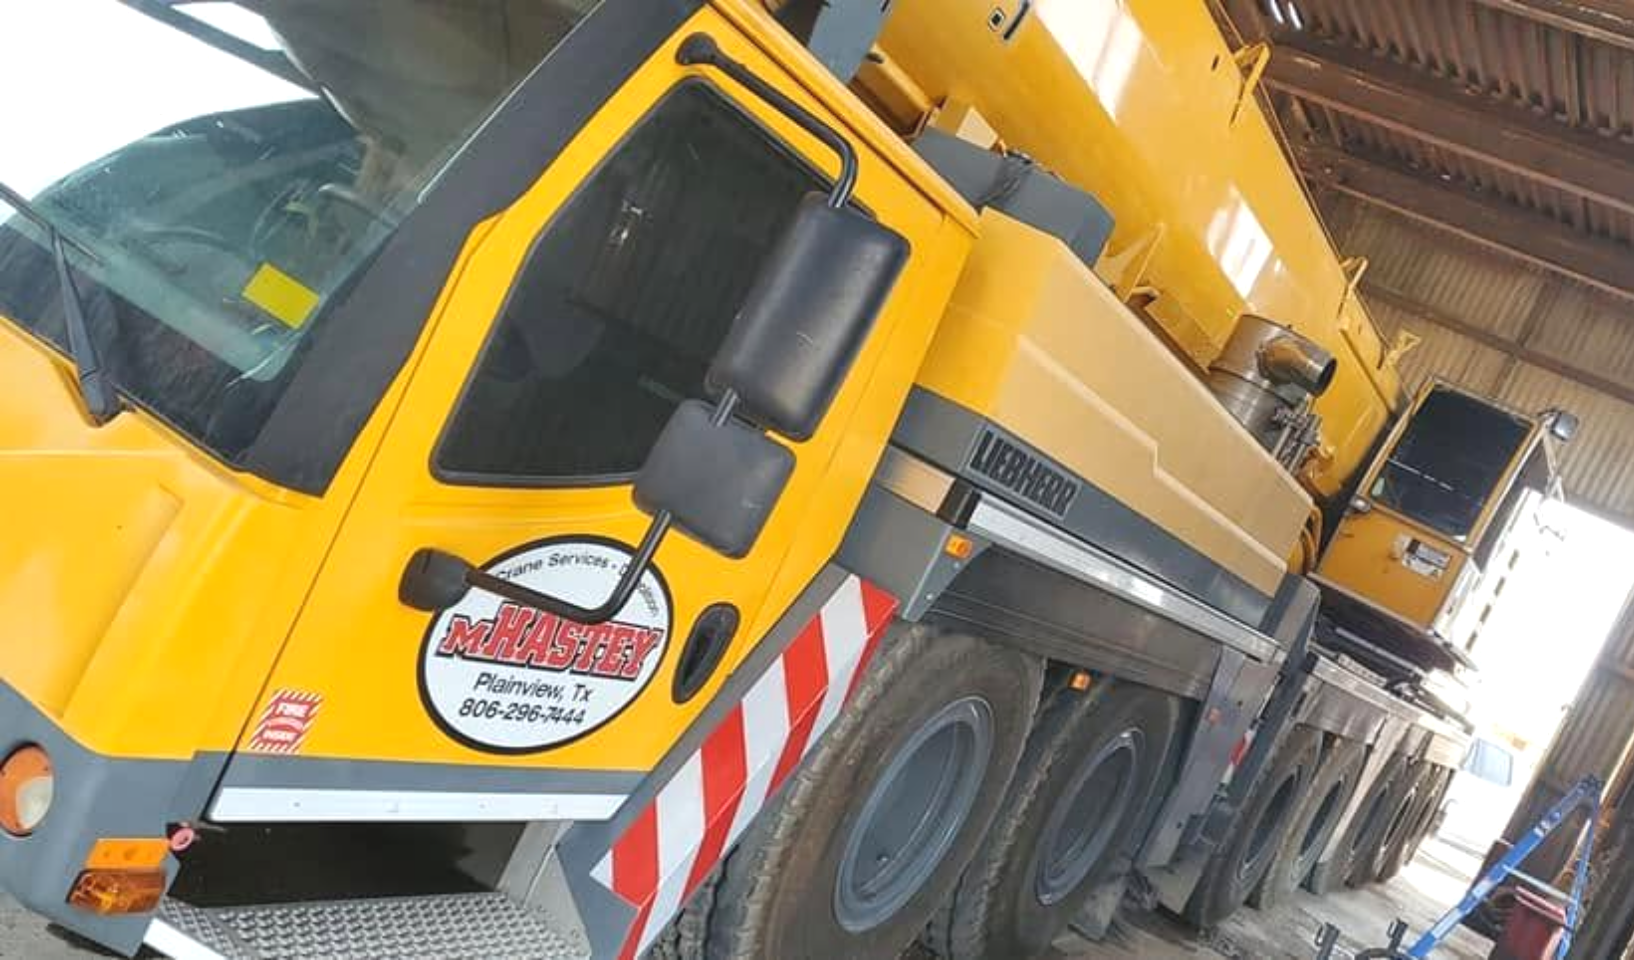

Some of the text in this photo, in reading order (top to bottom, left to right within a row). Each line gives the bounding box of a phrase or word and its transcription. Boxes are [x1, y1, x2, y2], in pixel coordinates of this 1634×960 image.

[968, 428, 1079, 518] LIEBHERR
[496, 558, 543, 581] Crane
[548, 552, 608, 570] Services
[473, 672, 594, 702] Plainview, Tx
[458, 698, 587, 724] 806-296-7444
